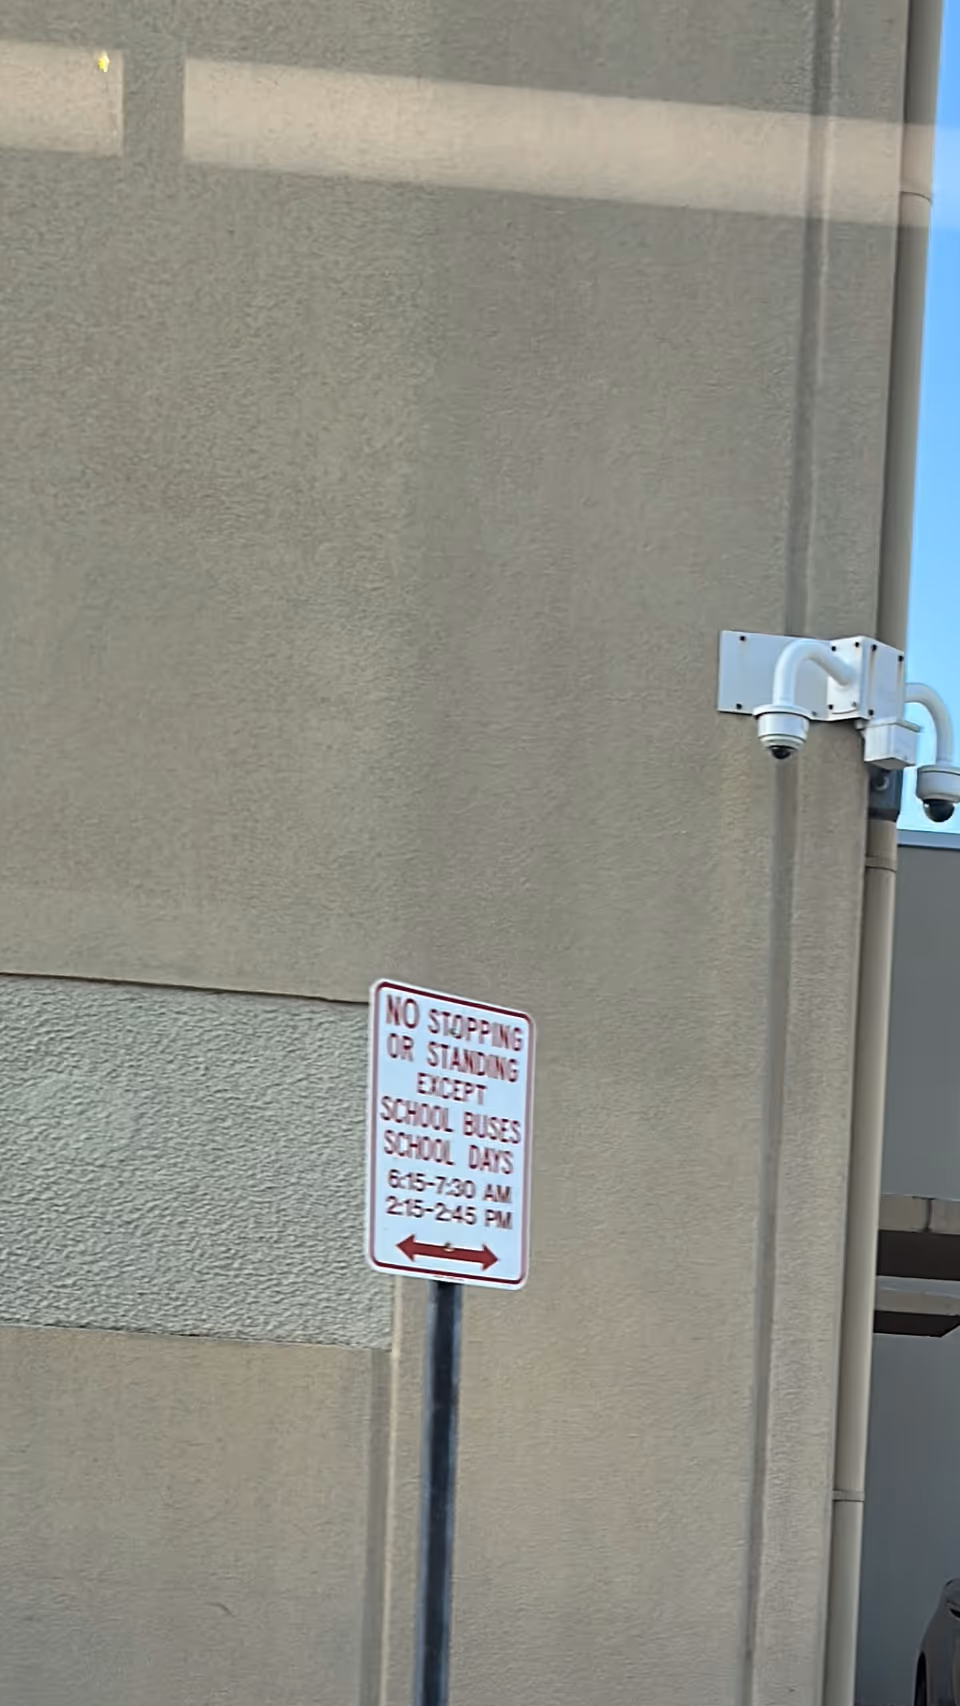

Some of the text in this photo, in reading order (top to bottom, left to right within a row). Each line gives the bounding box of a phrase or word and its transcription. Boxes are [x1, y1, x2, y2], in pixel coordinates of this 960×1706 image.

[386, 994, 523, 1052] NO STOPPING
[386, 1033, 518, 1082] OR STANDING
[416, 1072, 487, 1106] EXCEPT
[380, 1096, 522, 1144] SCHOOL BUSES
[384, 1130, 514, 1175] SCHOOL DAYS
[387, 1169, 512, 1204] 6:15-7:30 AM
[385, 1196, 512, 1230] 2:15-2:45 PM
